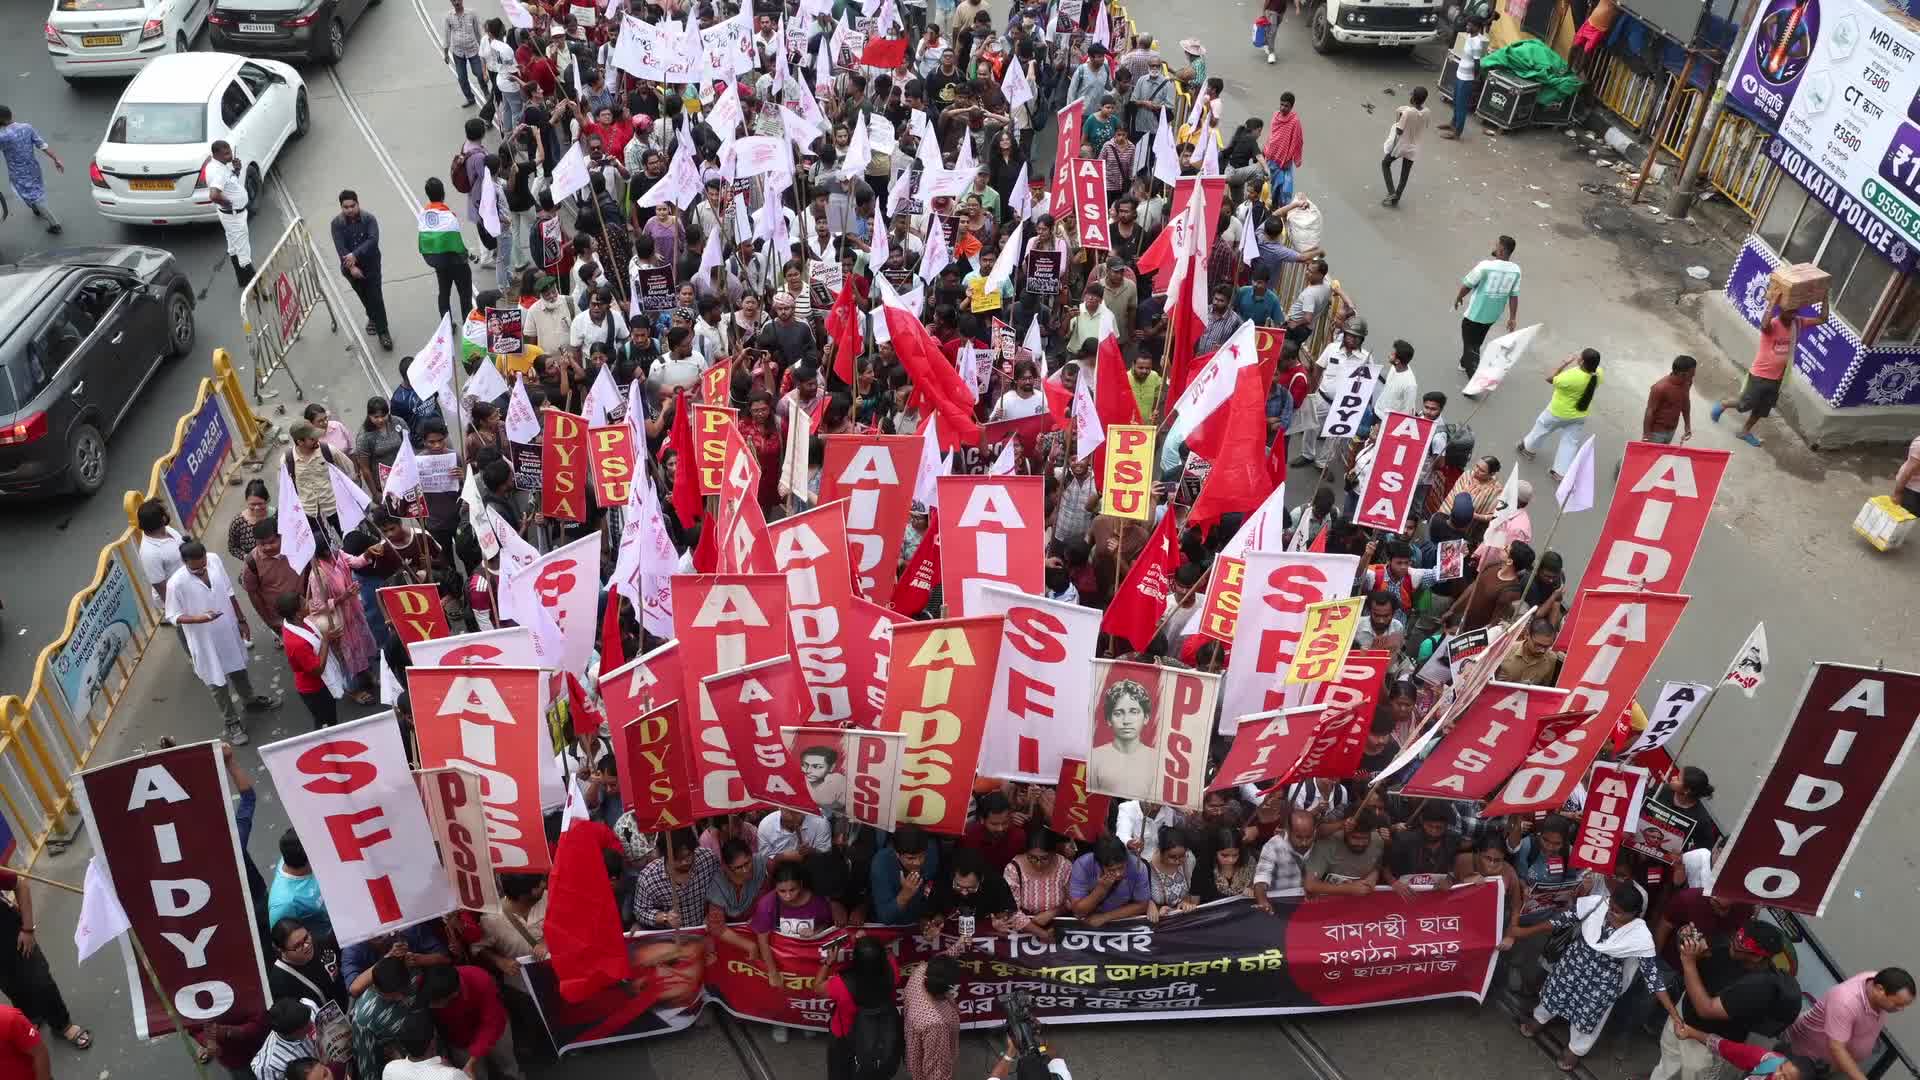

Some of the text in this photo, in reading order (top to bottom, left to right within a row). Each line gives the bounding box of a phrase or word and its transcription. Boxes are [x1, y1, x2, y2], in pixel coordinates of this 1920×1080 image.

[1863, 66, 1890, 93] ₹7500
[1869, 26, 1894, 52] MRI
[1833, 122, 1862, 153] ₹3500
[1844, 85, 1864, 107] CT
[1057, 110, 1075, 209] AISA
[1078, 160, 1105, 241] AISA
[1780, 144, 1893, 253] KOLKATA POLICE
[186, 413, 221, 476] Baazar
[1326, 365, 1371, 436] AIDYO
[552, 415, 579, 518] DYSA
[596, 430, 632, 502] PSU
[700, 410, 729, 488] PSU
[1111, 430, 1148, 513] PSU
[1367, 417, 1421, 521] AISA
[1601, 454, 1699, 592] AID
[70, 566, 123, 656] KOLKATA TRAFFIC POLICE
[774, 523, 851, 722] AIDSO
[1296, 606, 1353, 680] PSU
[738, 678, 796, 797] AISA
[897, 627, 977, 826] AIDSO
[1004, 606, 1069, 775] SFI
[640, 715, 681, 828] DYSA
[1162, 674, 1205, 806] PSU
[1432, 691, 1529, 792] AISA
[295, 740, 404, 925] SFI
[1577, 779, 1629, 864] AIDSO
[1744, 678, 1886, 898] AIDYO
[436, 772, 485, 910] PSU
[128, 763, 235, 1021] AIDYO
[1322, 914, 1461, 943] বামপন্থী ছাত্র
[1104, 957, 1232, 981] অপসারণ
[1237, 949, 1283, 972] চাই
[1320, 940, 1397, 966] সংগঠন
